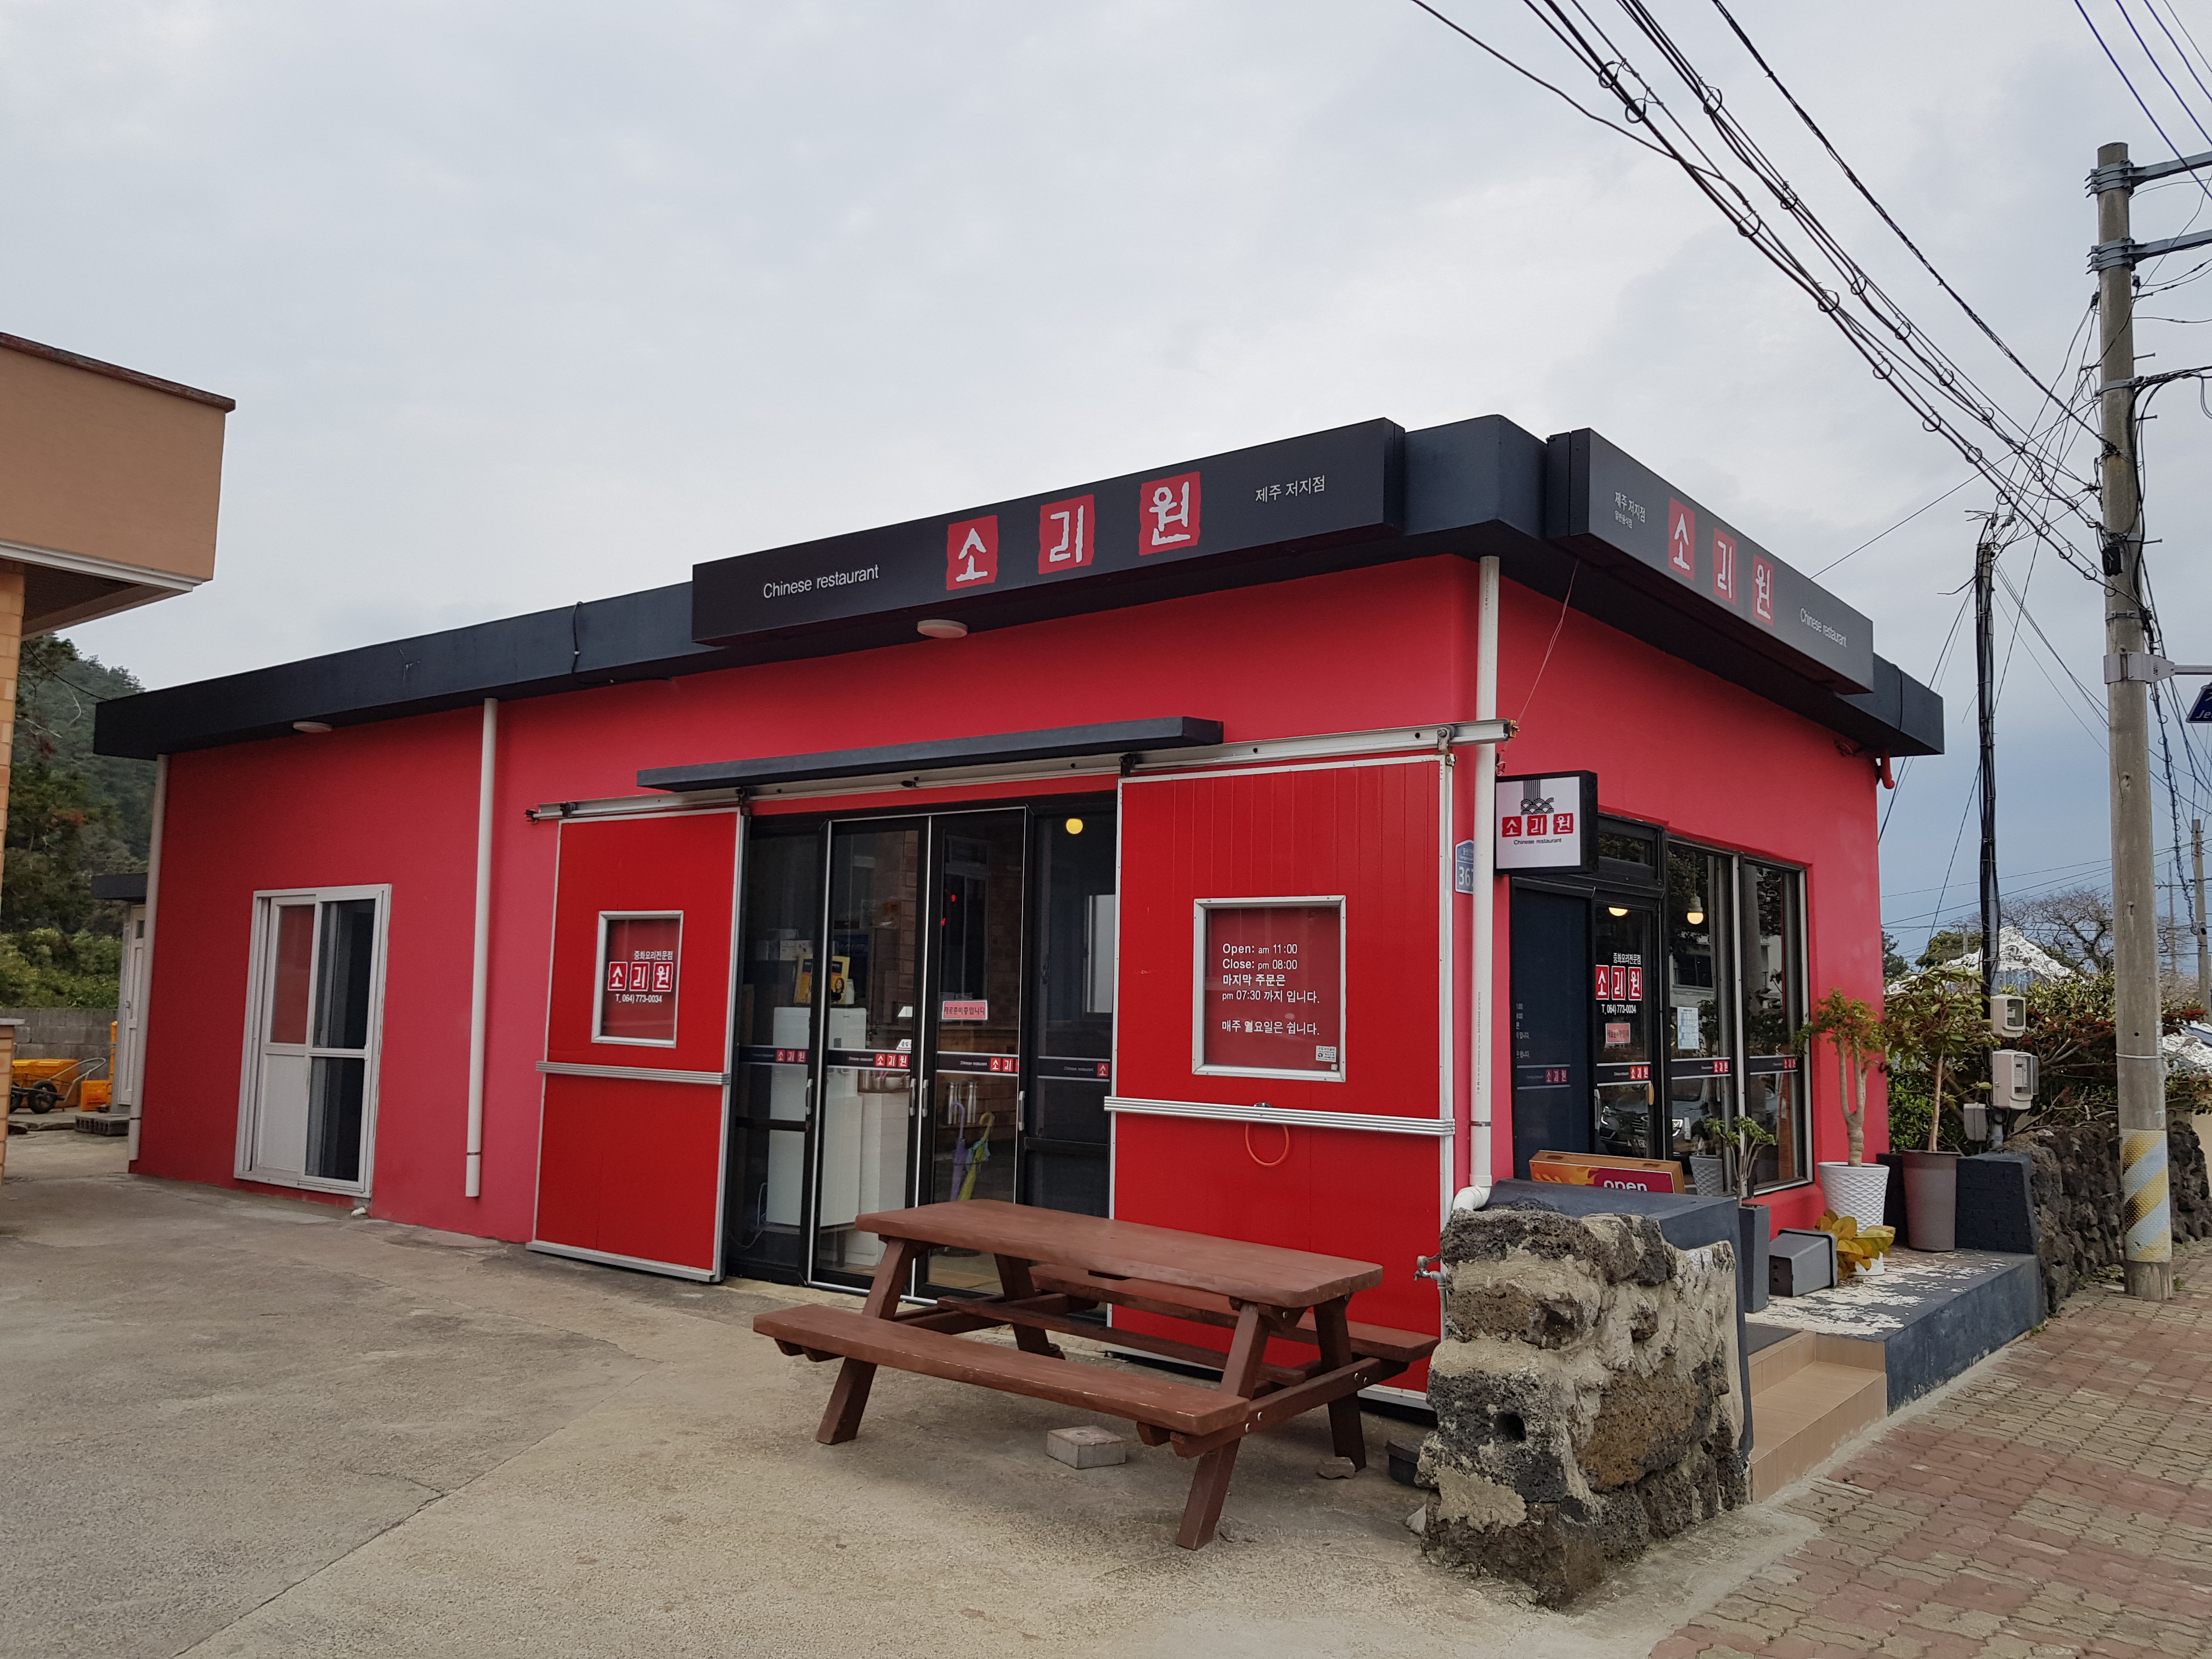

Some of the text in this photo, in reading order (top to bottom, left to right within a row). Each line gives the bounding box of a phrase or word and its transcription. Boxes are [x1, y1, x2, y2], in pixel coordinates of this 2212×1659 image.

[1255, 475, 1325, 503] 제주 저지점
[1615, 492, 1645, 523] 제주 저지점
[763, 564, 879, 599] Chinese restaurant
[1800, 607, 1847, 647] Chinese restaurant
[2195, 709, 2212, 719] Je
[1459, 866, 1474, 887] 36
[634, 951, 673, 960] 중화요리전문점
[1222, 943, 1255, 956] Open:
[1273, 944, 1298, 954] 11:00
[1222, 958, 1298, 971] Close: pm 08:00
[1613, 952, 1641, 964] 중화요리전문점
[1223, 973, 1286, 986] 마지막 주문은
[622, 994, 635, 1004] 064)
[635, 994, 662, 1003] 773-0034
[1222, 990, 1320, 1003] pm 07:30 까지 입니다.
[1617, 1004, 1637, 1014] 773-0034
[1222, 1020, 1320, 1035] 매주 월요일은 쉽니다.
[992, 1059, 1019, 1071] 소리
